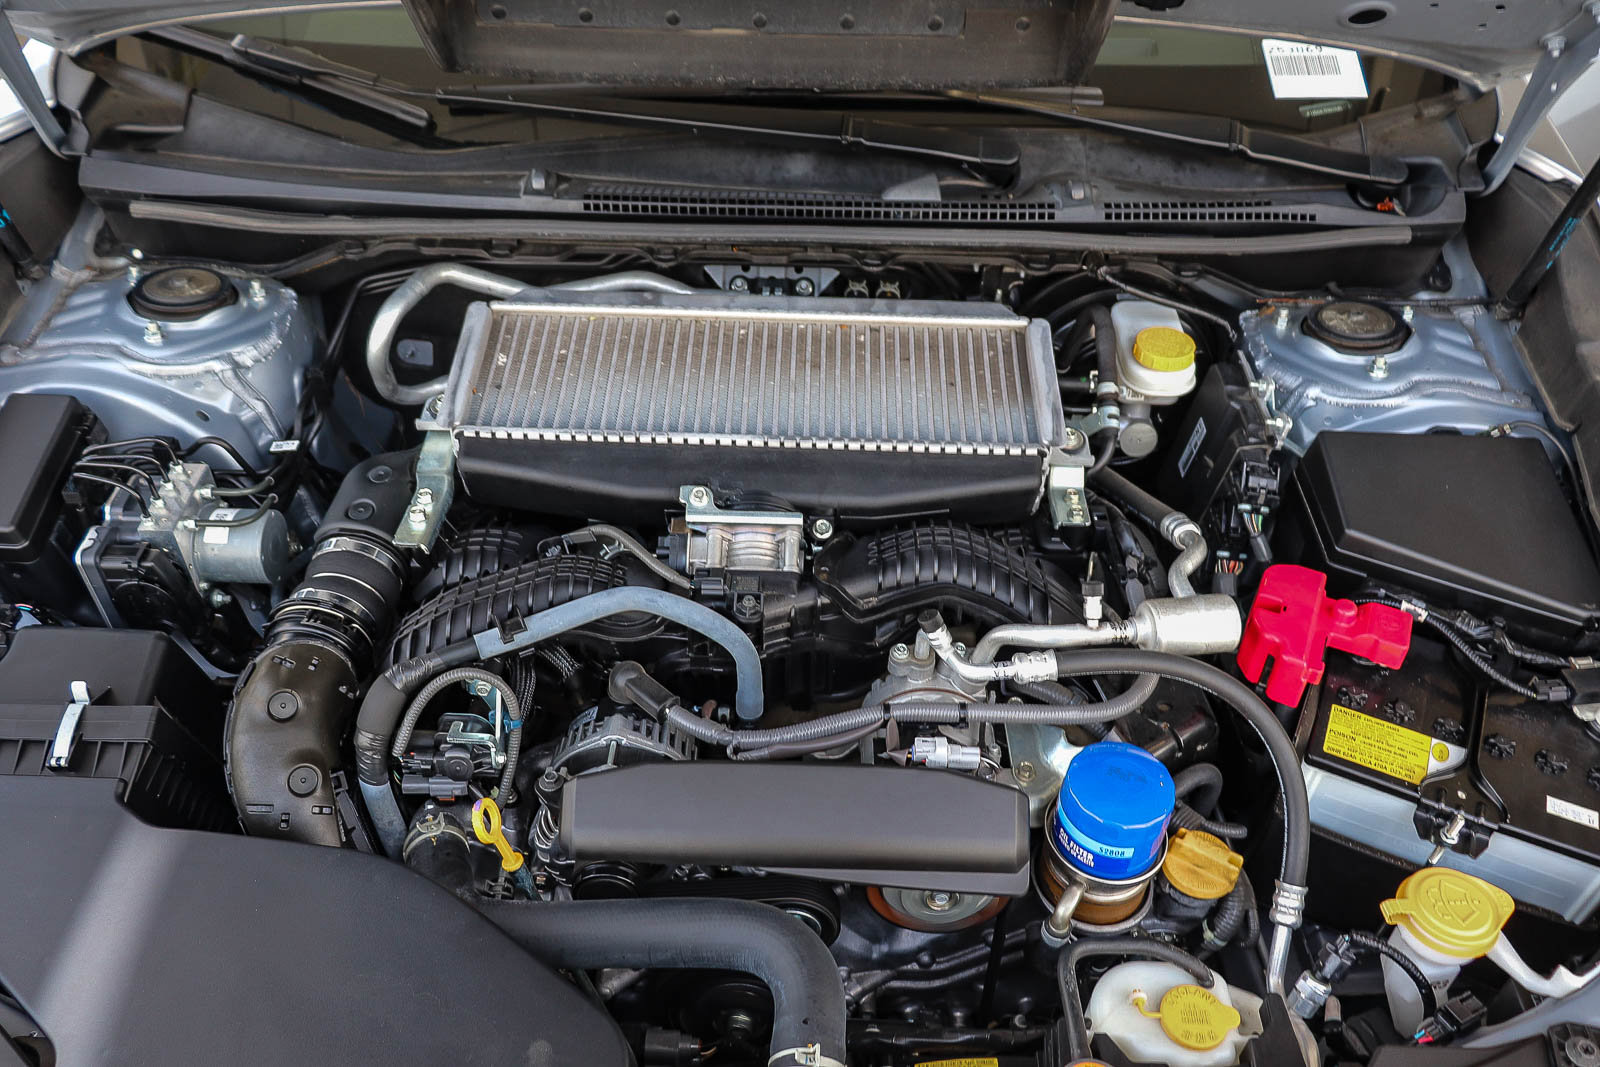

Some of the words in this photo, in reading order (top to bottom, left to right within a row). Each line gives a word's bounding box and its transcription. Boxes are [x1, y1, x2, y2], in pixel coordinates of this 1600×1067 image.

[1334, 706, 1362, 720] DANGER
[1329, 729, 1356, 742] POISON
[1060, 827, 1068, 844] OIL
[1070, 840, 1094, 862] FILTER
